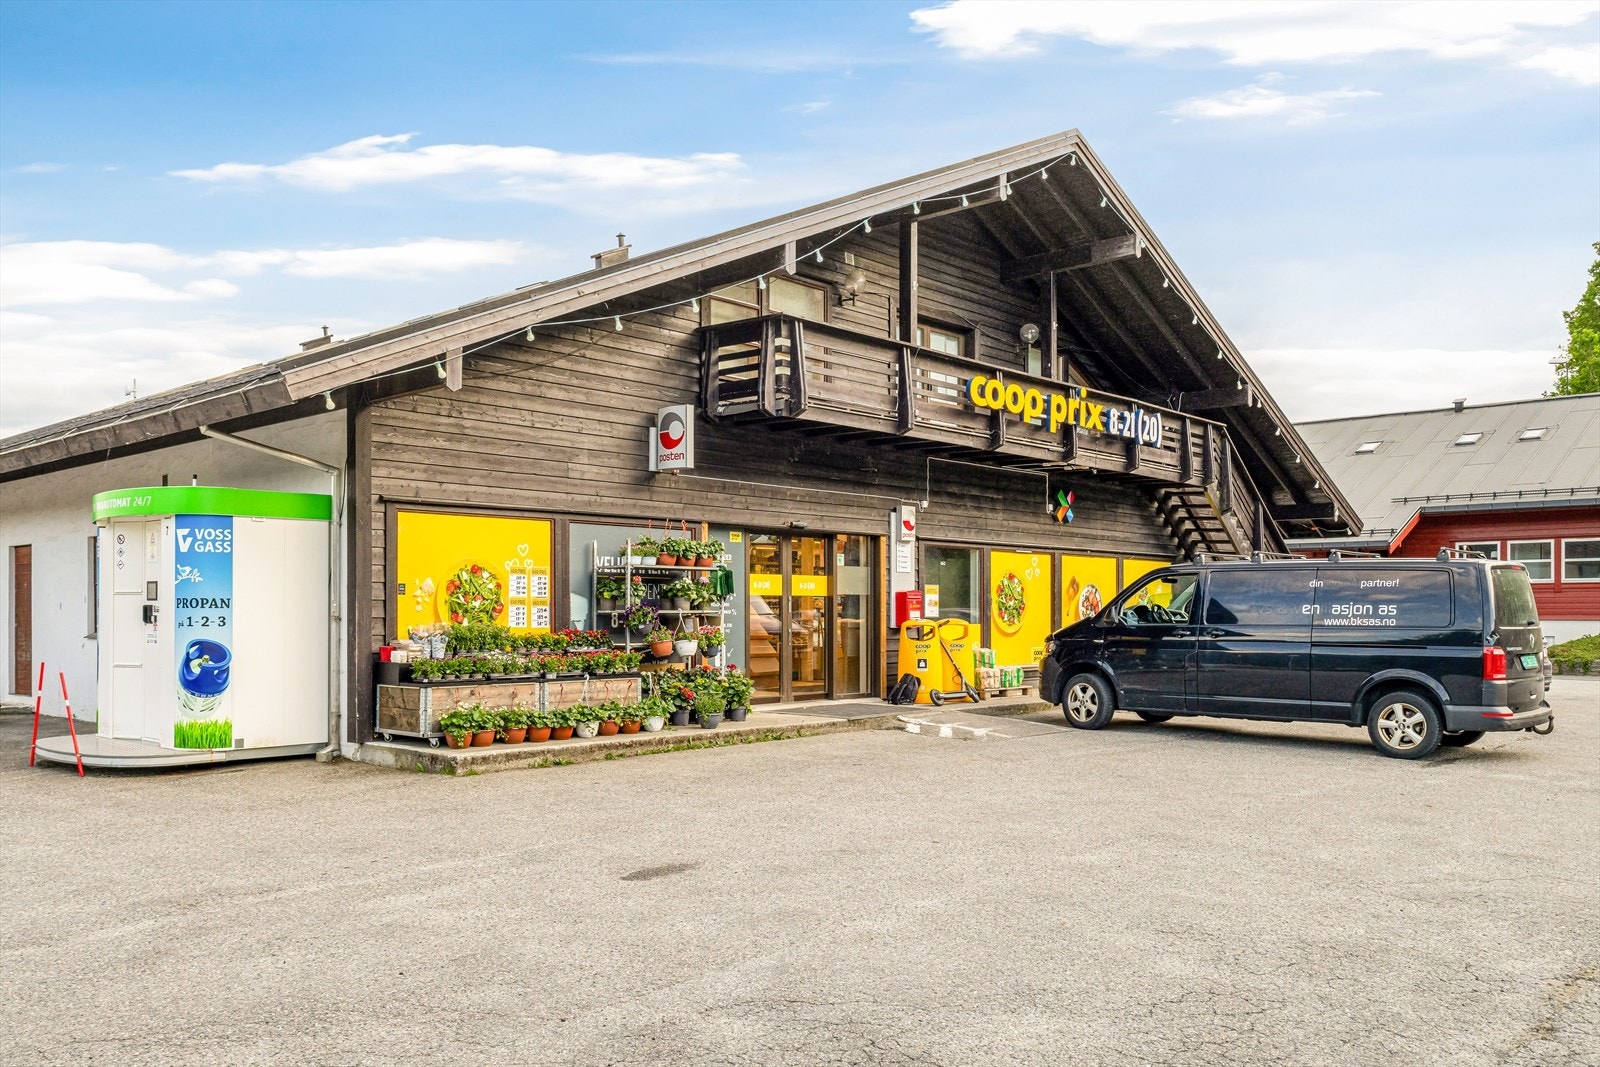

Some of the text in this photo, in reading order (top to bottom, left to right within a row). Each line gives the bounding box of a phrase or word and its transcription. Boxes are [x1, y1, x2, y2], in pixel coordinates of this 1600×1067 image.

[967, 375, 1163, 448] coop prix 8-21 (20)
[659, 452, 685, 464] posten
[133, 496, 151, 507] 24/7
[194, 528, 232, 541] VOSS
[194, 541, 232, 553] GASS
[1309, 578, 1400, 589] din partner!
[176, 597, 231, 609] PROPAN
[1302, 604, 1320, 615] en
[1332, 602, 1373, 617] asjon
[1378, 604, 1398, 615] as
[1324, 617, 1396, 626] www.bksas.no
